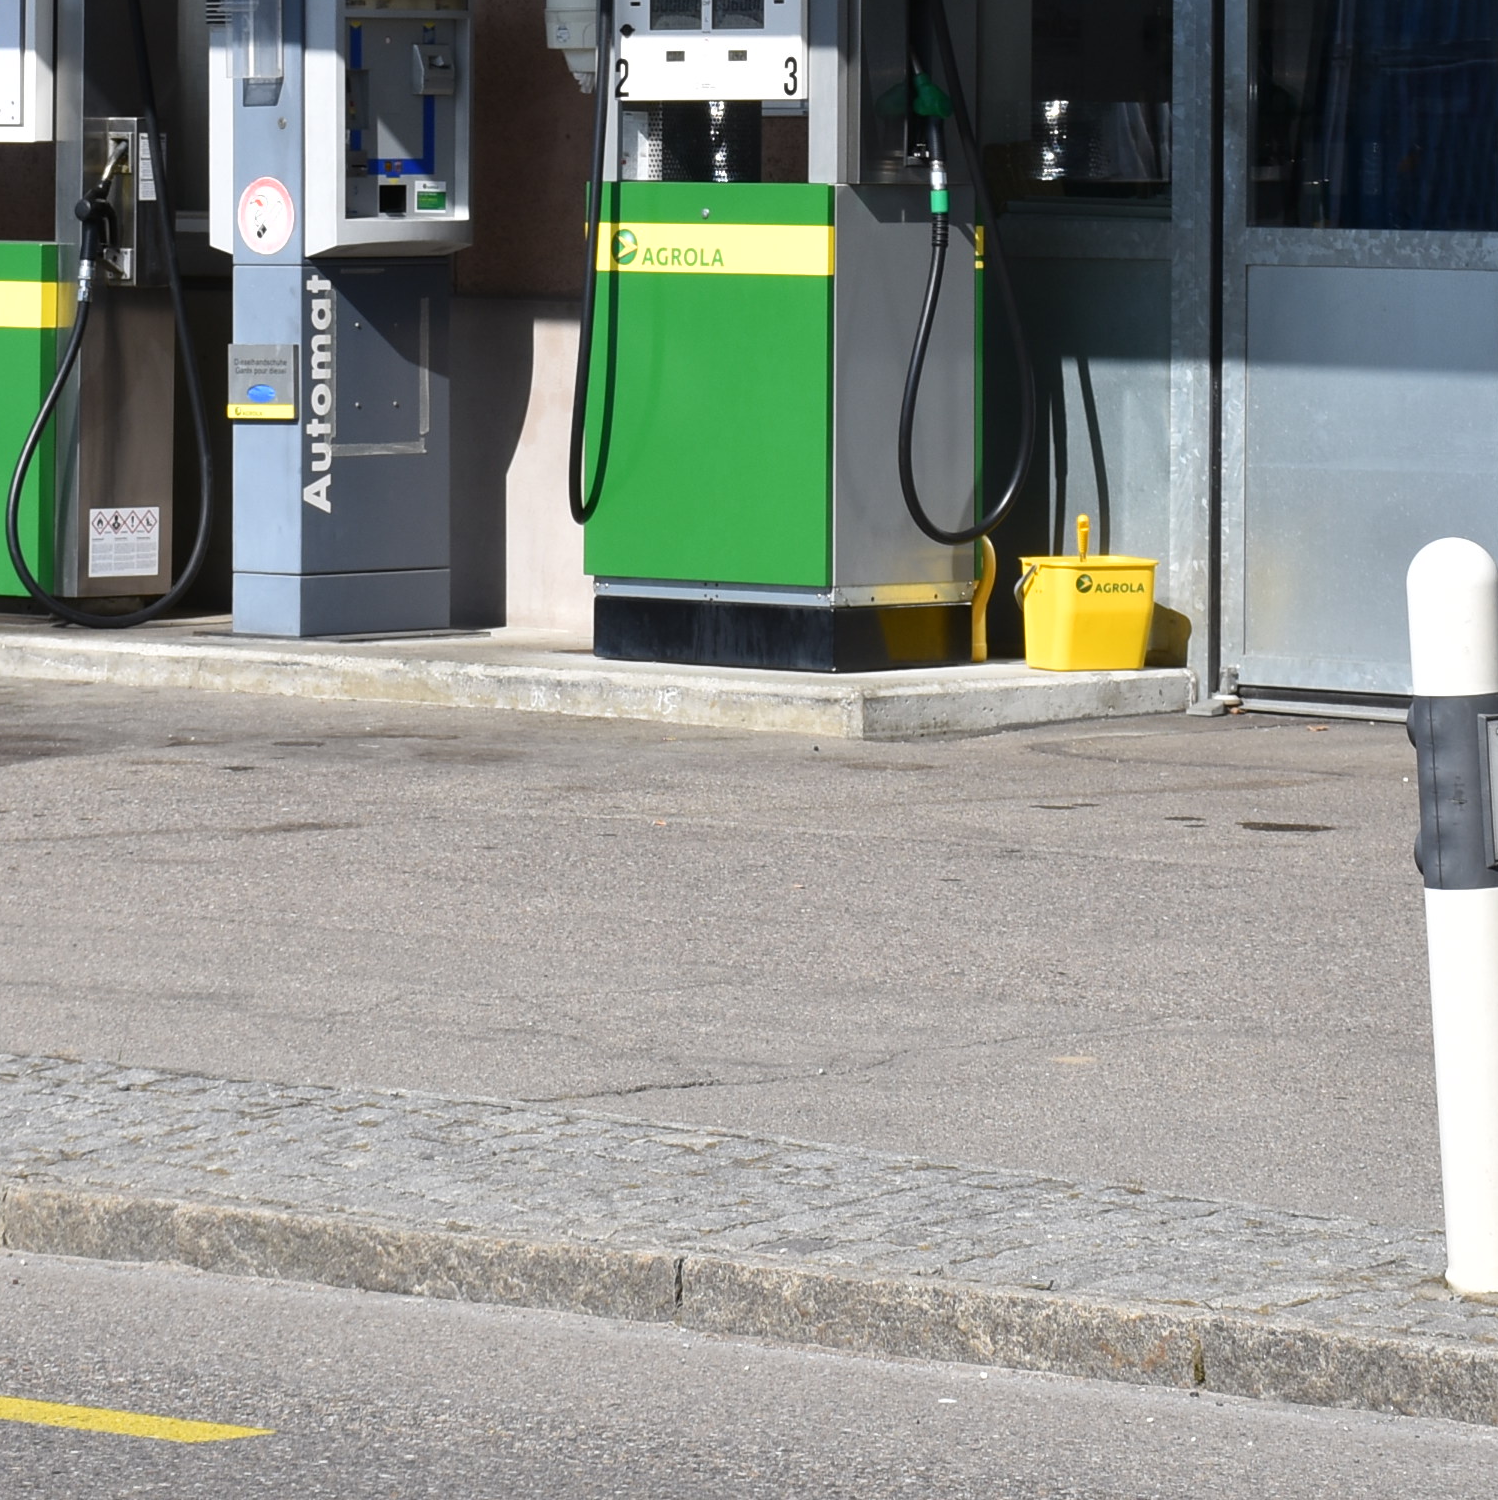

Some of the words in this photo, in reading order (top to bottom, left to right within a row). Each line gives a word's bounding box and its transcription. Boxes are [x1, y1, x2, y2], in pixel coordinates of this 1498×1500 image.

[615, 58, 630, 98] 2
[783, 56, 798, 96] 3
[641, 247, 725, 267] AGROLA
[303, 274, 332, 514] Automat
[1094, 582, 1145, 594] AGROLA
